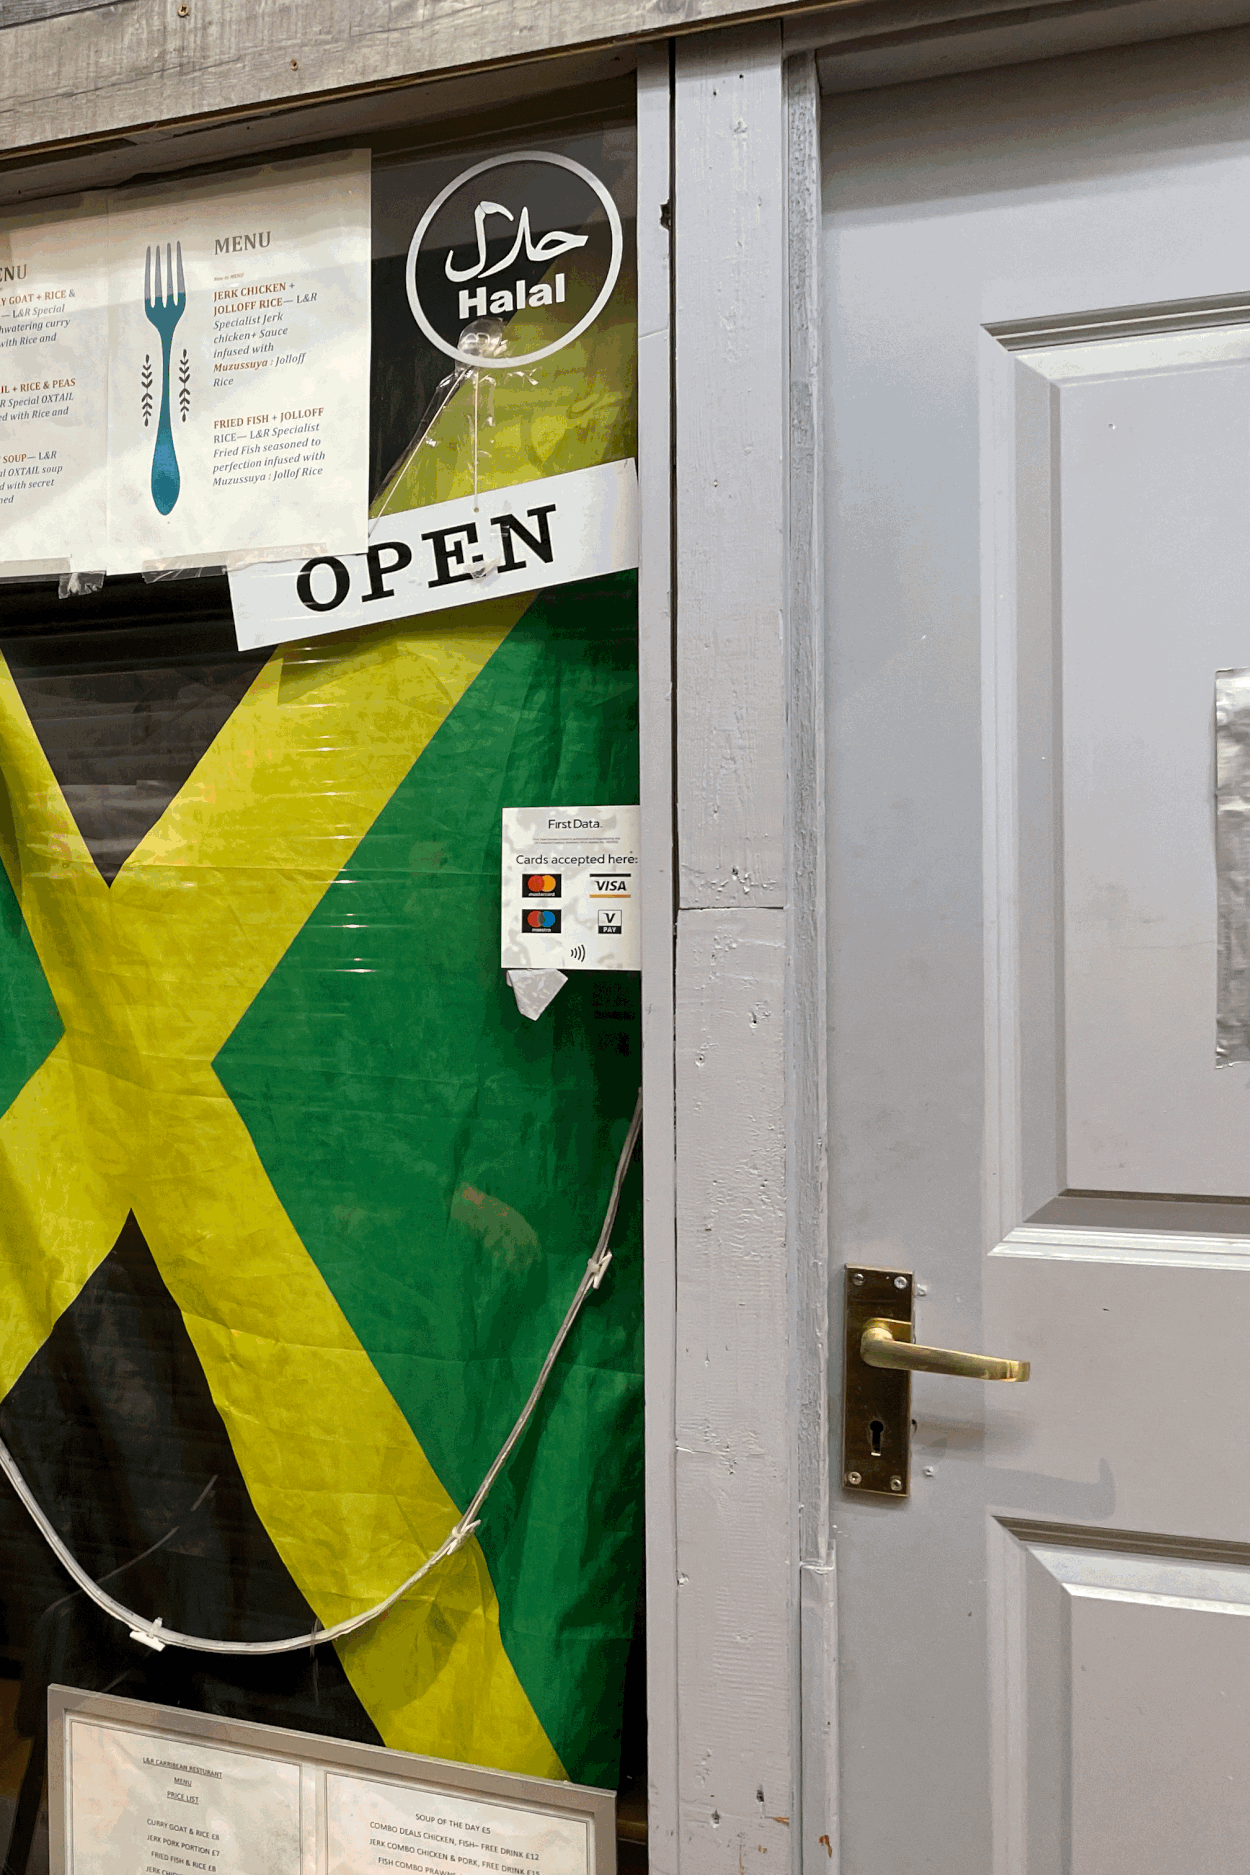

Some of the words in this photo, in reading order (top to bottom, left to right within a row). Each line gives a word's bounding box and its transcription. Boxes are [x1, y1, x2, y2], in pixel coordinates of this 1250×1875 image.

[214, 231, 271, 255] MENU
[445, 201, 588, 282] حلال
[458, 273, 566, 319] Halal
[45, 319, 71, 328] curry
[213, 315, 260, 331] Specialist
[262, 311, 283, 325] Jerk
[214, 417, 244, 429] FRIED
[246, 414, 269, 426] FISH
[280, 407, 324, 422] JOLLOFF
[212, 459, 262, 474] perfection
[264, 454, 300, 467] infused
[303, 451, 325, 462] with
[295, 503, 556, 613] OPEN
[548, 819, 572, 829] First
[516, 855, 548, 865] Cards
[551, 854, 605, 866] accepted
[608, 854, 638, 864] here:
[596, 880, 627, 891] VISA
[603, 912, 616, 924] V
[415, 1814, 435, 1823] SOUP
[449, 1820, 463, 1829] THE
[465, 1823, 480, 1831] DAY
[482, 1826, 491, 1834] £5
